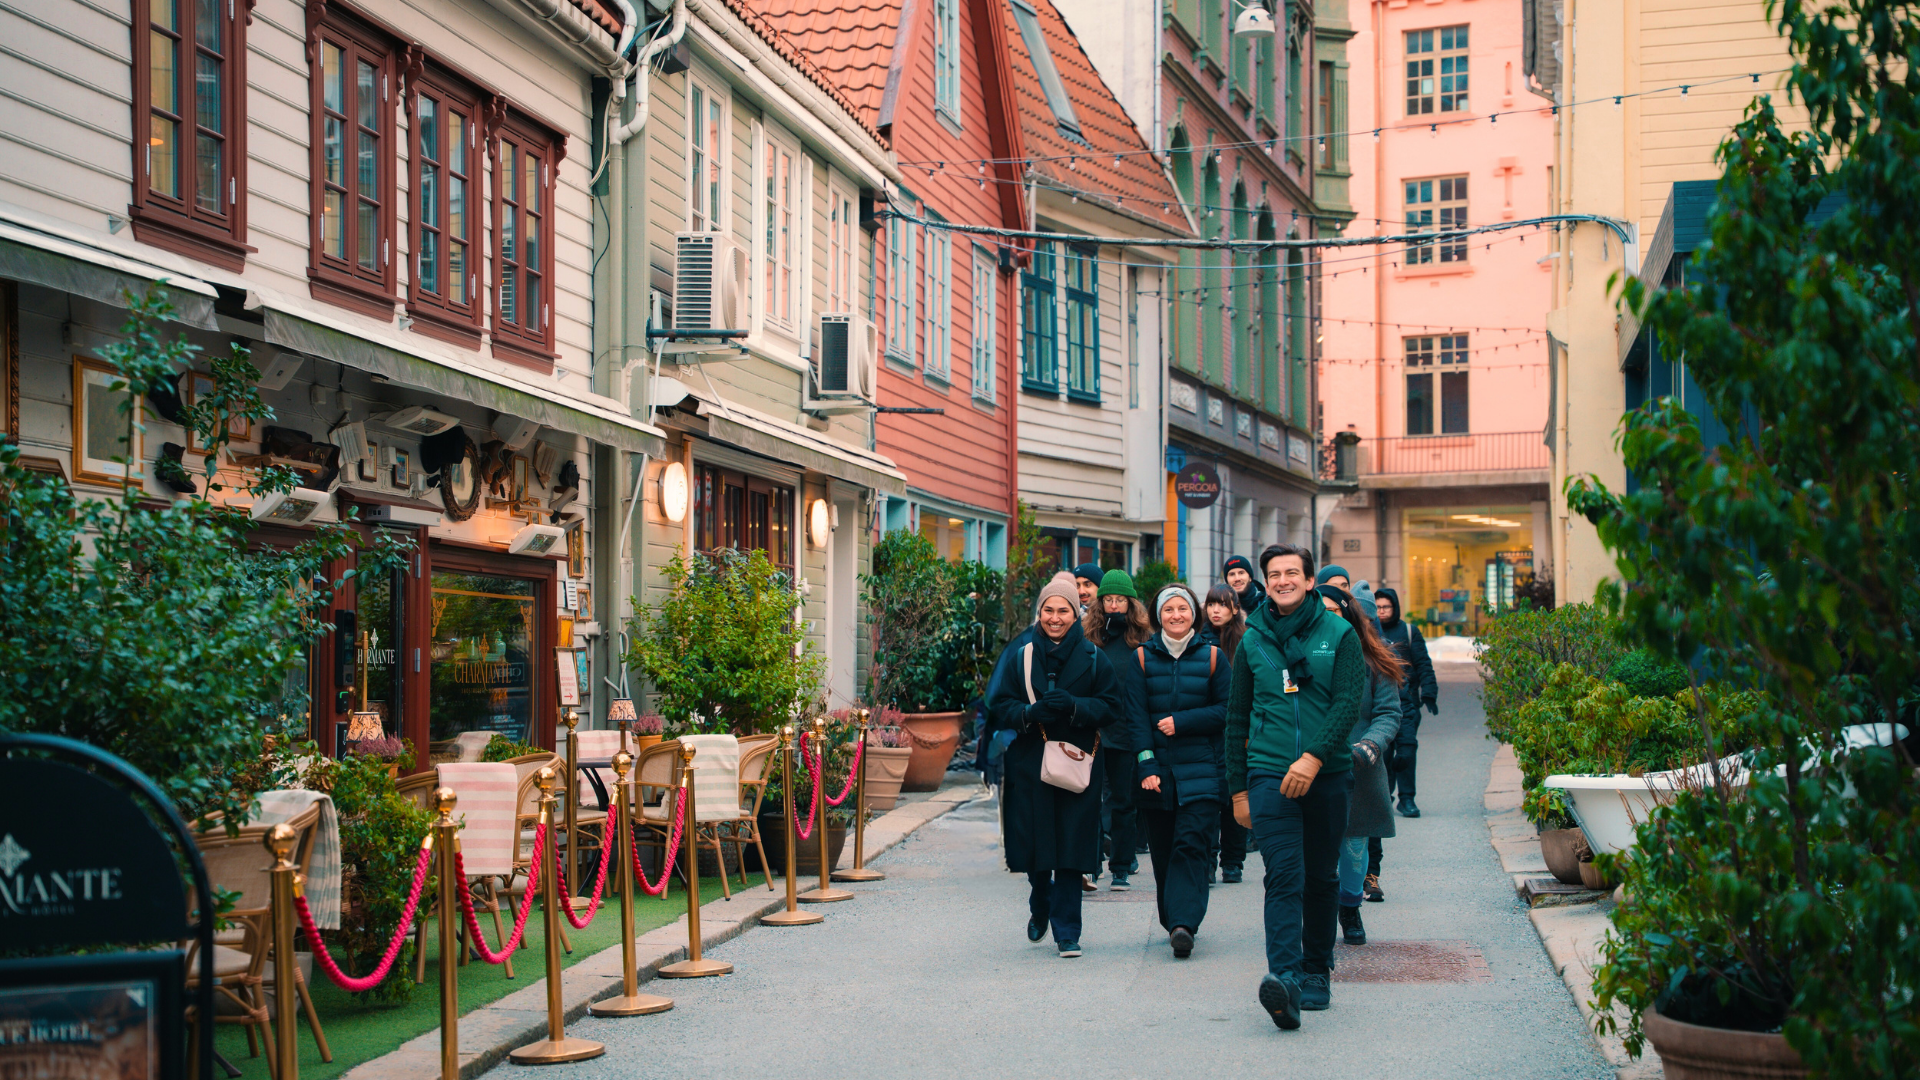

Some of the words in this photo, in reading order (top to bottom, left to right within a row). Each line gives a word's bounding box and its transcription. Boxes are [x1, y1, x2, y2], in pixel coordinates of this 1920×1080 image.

[1178, 482, 1218, 492] PERGOLA
[1345, 541, 1360, 551] 22
[357, 648, 396, 665] HRMANTE
[454, 661, 512, 685] CHARMANTE
[0, 868, 123, 908] MANTE
